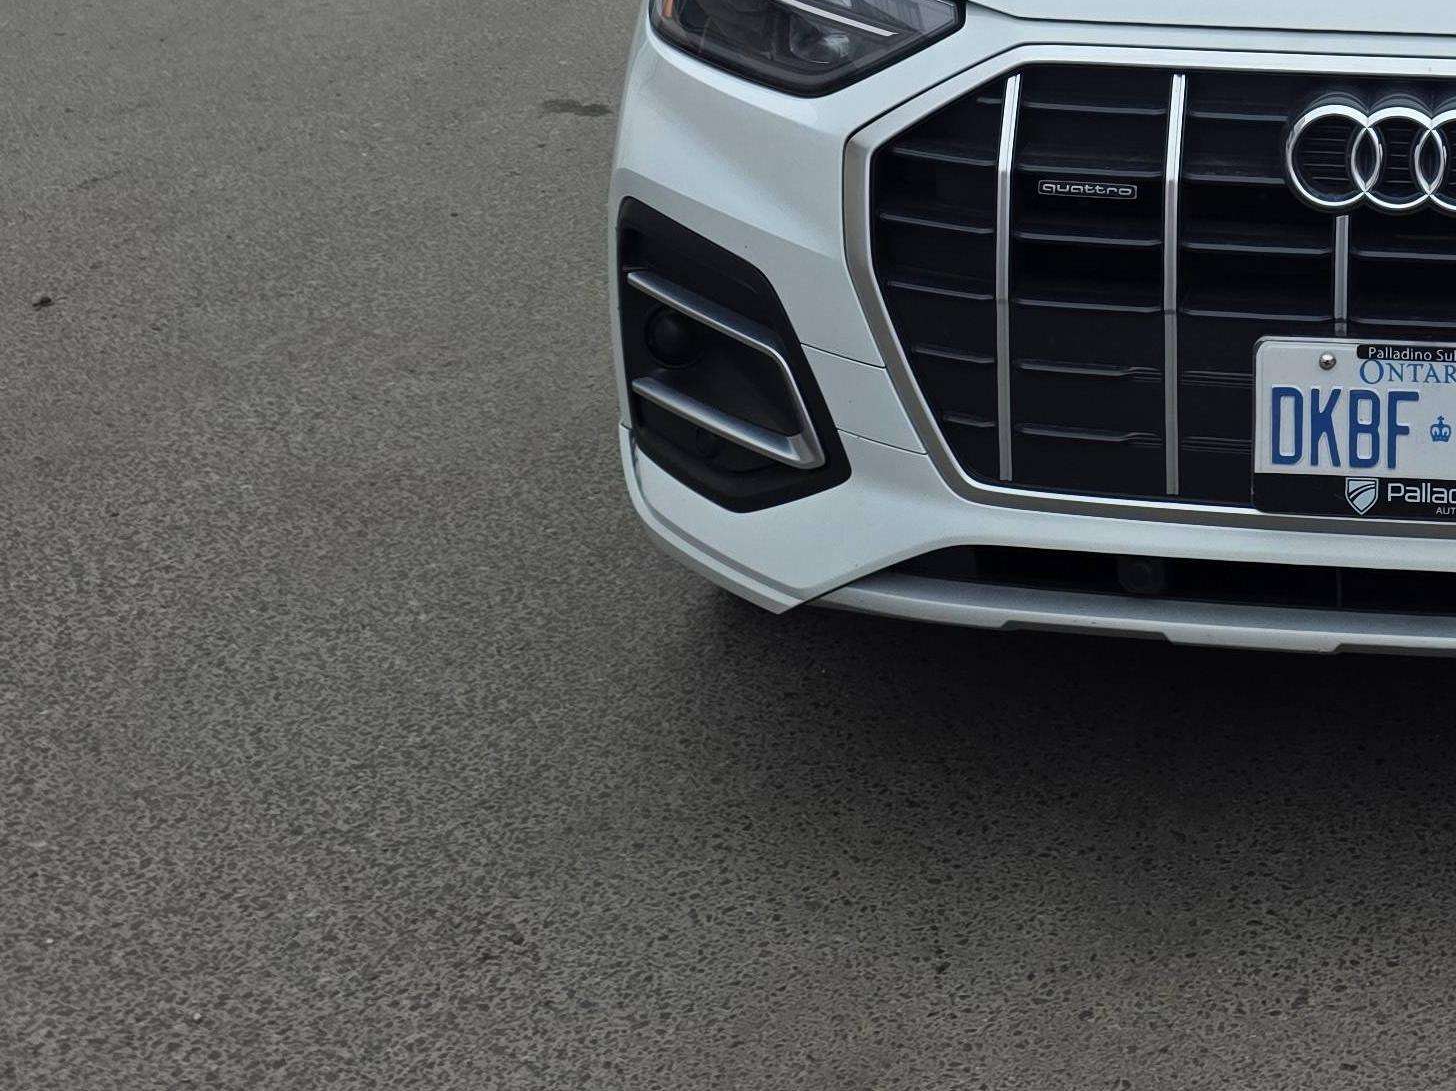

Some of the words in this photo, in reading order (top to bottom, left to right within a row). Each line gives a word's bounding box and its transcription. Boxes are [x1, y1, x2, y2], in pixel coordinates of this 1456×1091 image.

[1042, 183, 1132, 196] quattro
[1368, 346, 1432, 361] Palladino
[1272, 387, 1420, 469] DKBF
